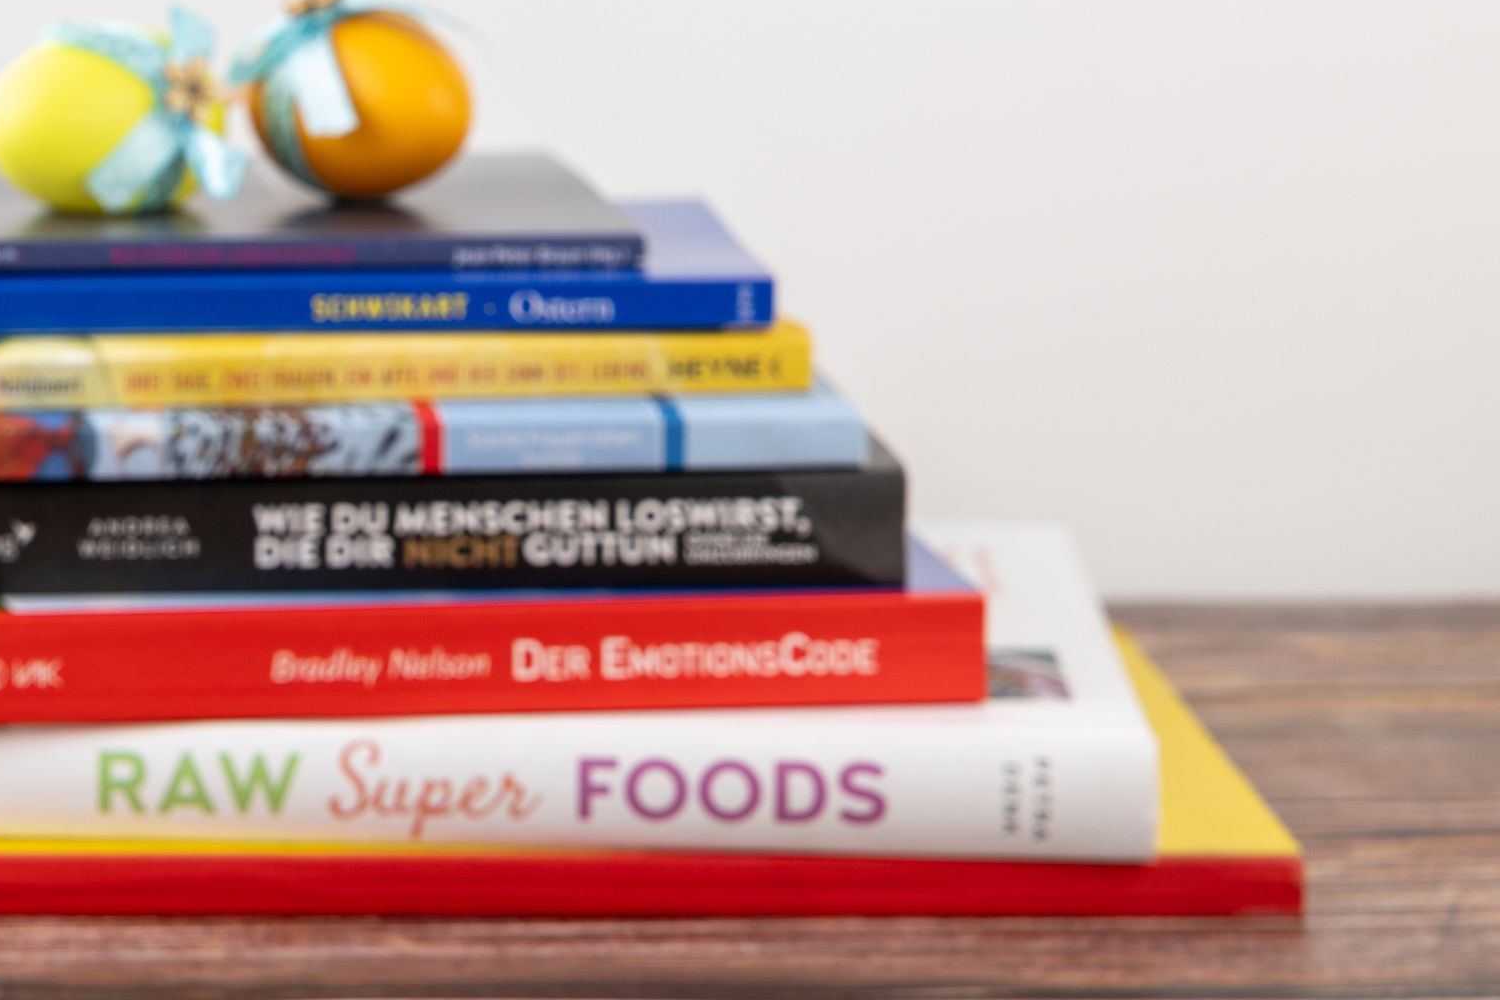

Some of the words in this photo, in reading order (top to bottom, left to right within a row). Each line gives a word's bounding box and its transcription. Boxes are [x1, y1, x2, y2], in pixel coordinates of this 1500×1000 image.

[88, 515, 191, 538] ANDREA
[252, 502, 327, 535] WIE
[329, 500, 390, 535] DU
[393, 498, 608, 536] MENSCHEN
[614, 496, 812, 538] LOSWIRST,
[253, 535, 321, 570] DIE
[324, 535, 396, 570] DIR
[402, 534, 519, 569] NICHT
[521, 531, 677, 568] GUTTUN
[269, 648, 384, 690] Bradley
[387, 644, 493, 681] Nelson
[96, 748, 302, 816] RAW
[327, 738, 542, 843] Super
[575, 757, 889, 826] FOODS
